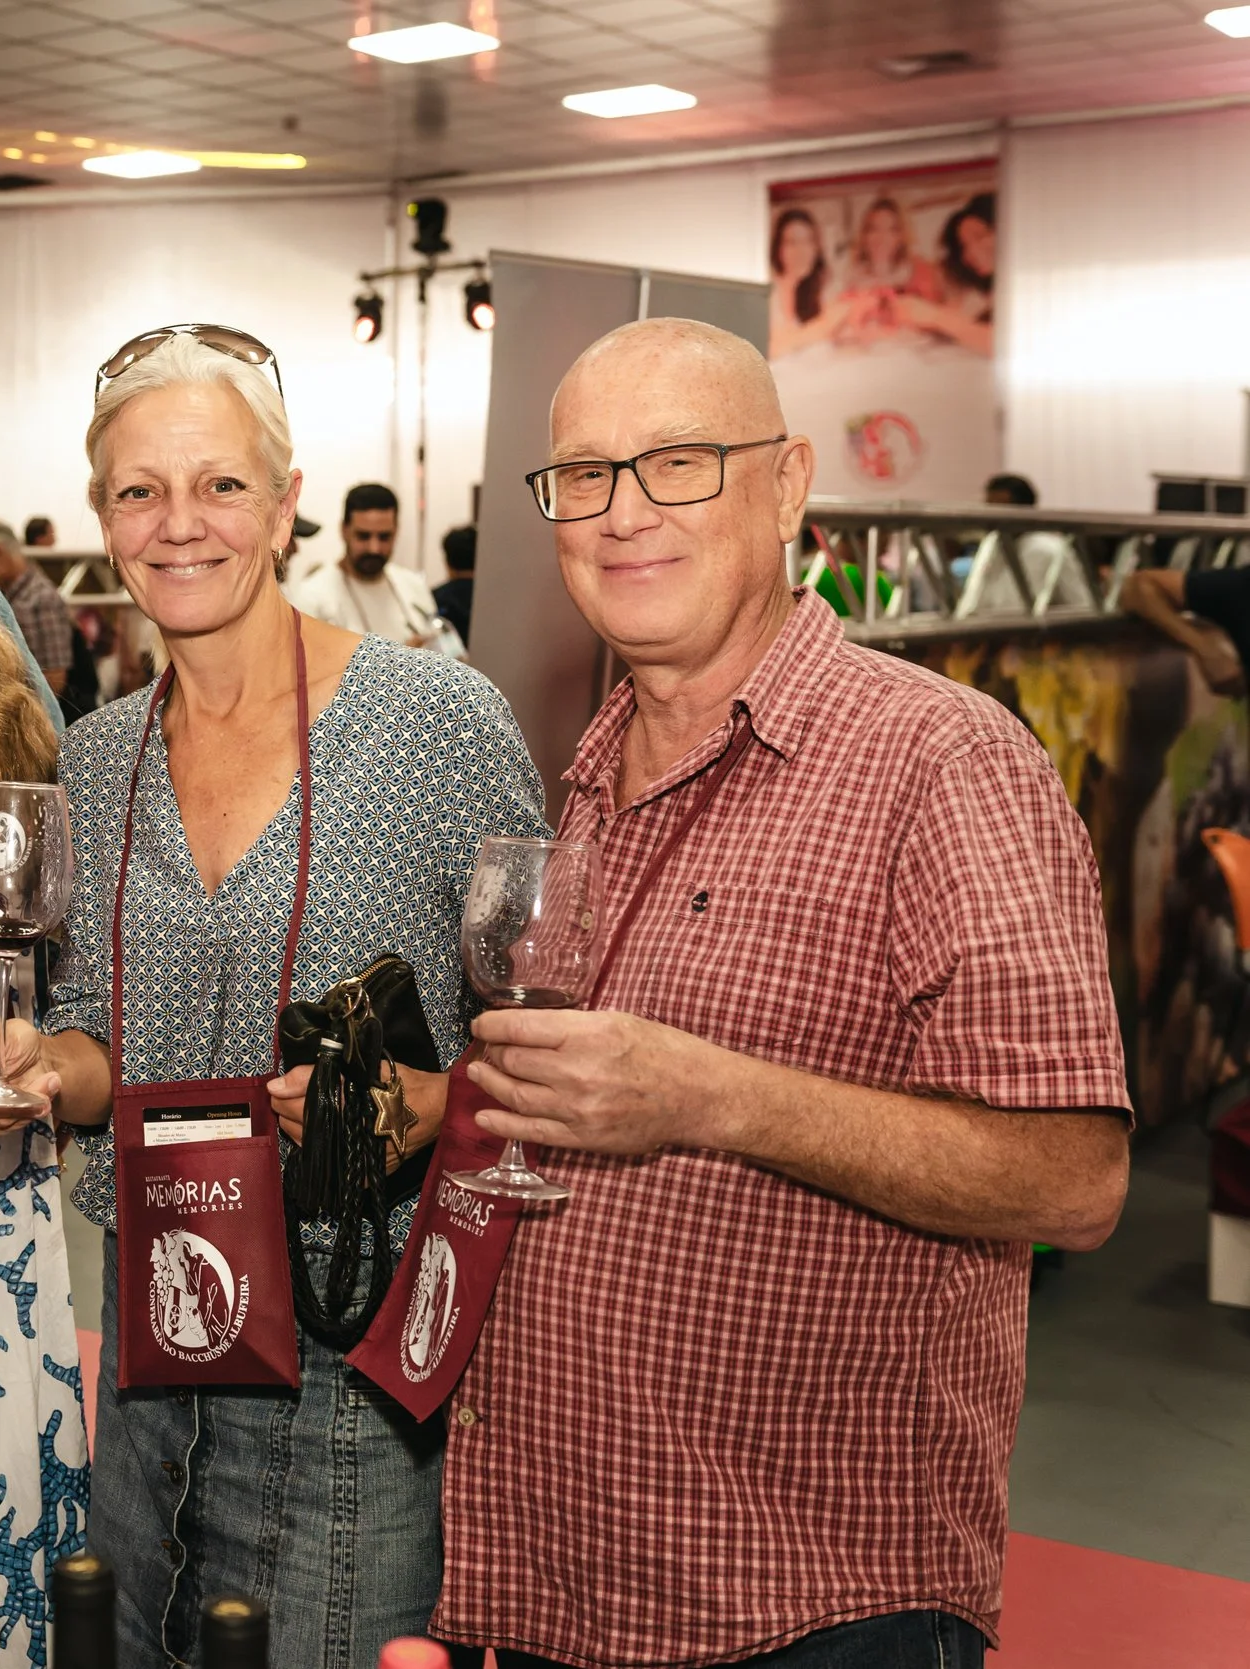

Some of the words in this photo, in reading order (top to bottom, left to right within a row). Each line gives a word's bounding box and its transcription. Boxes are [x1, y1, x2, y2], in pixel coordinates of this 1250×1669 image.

[206, 1111, 228, 1119] Opening
[146, 1177, 242, 1208] MEMÓRIAS
[177, 1201, 244, 1215] MEMORIES
[449, 1213, 486, 1238] MEMORIES
[162, 1342, 178, 1357] DO
[178, 1348, 222, 1363] BACCHUS
[220, 1338, 233, 1354] DE
[228, 1273, 250, 1342] ALBUFEIRA
